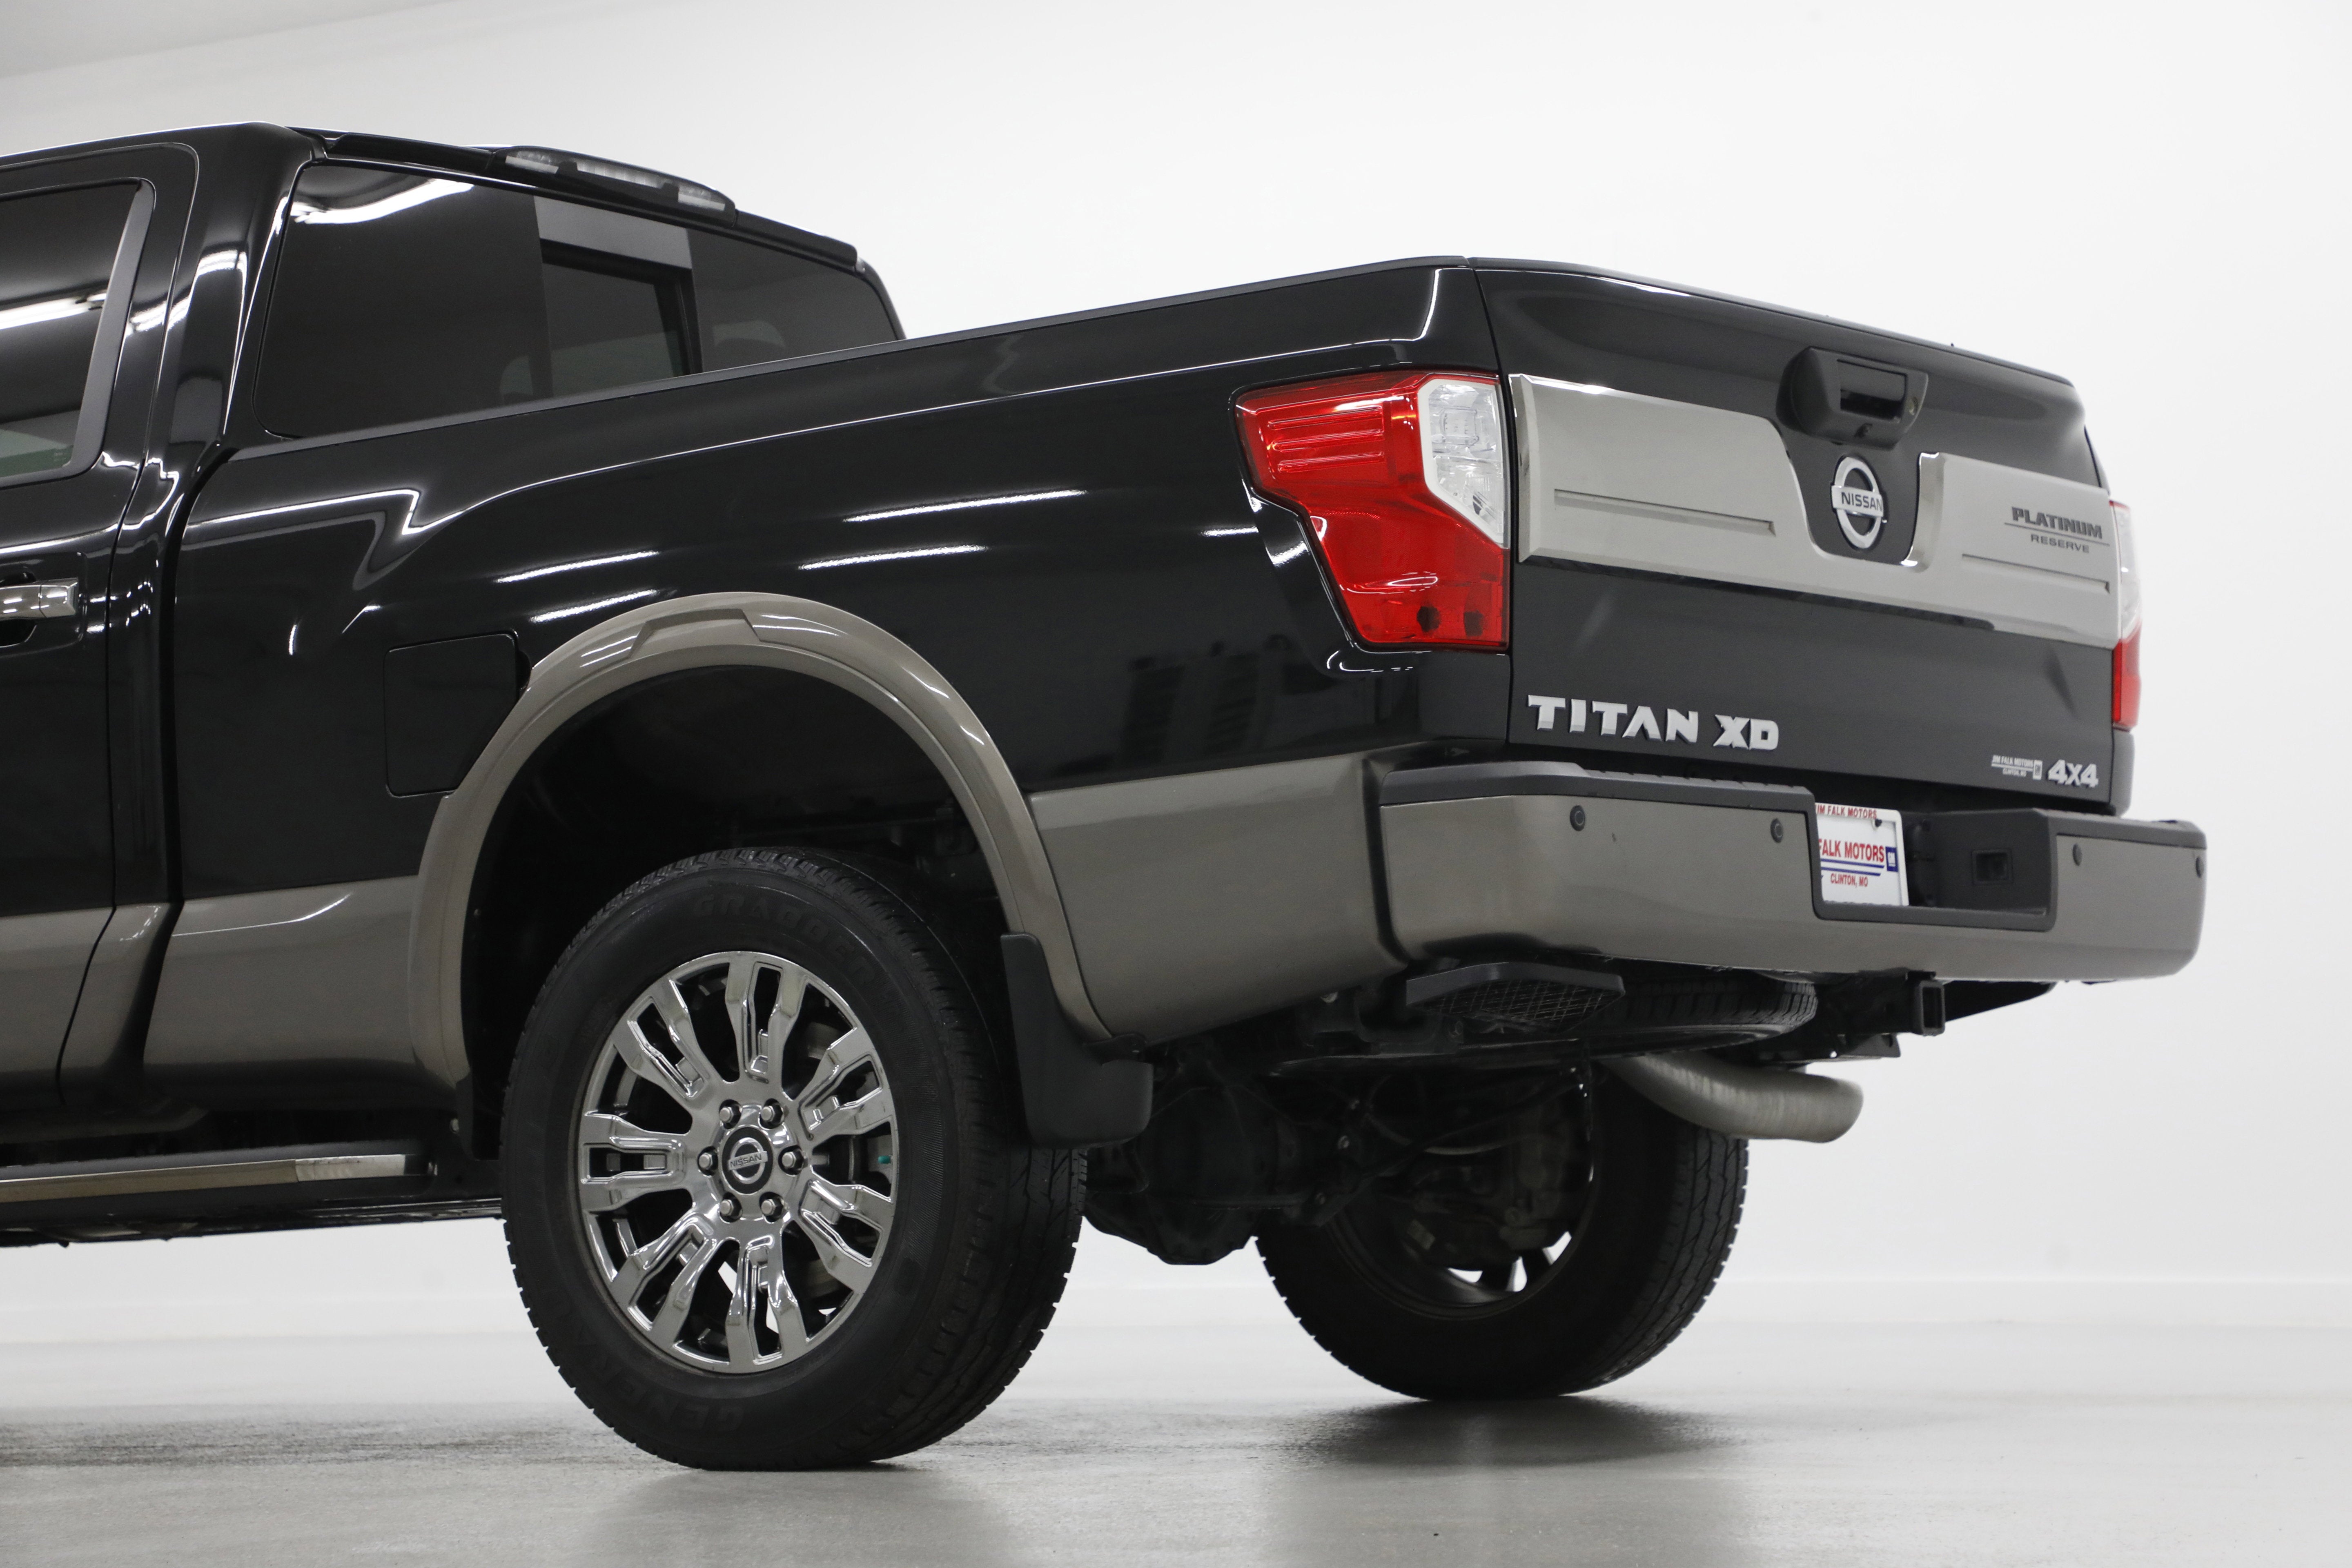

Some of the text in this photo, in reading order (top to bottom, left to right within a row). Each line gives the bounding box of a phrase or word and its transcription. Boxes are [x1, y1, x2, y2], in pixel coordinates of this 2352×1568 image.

[1841, 492, 1883, 511] NISSAN
[2011, 506, 2103, 539] PLATINUM
[2030, 533, 2089, 553] RESERVE
[1528, 695, 1779, 751] TITAN XD
[1827, 805, 1845, 816] FALK
[1847, 807, 1877, 819] MOTORS
[1844, 841, 1884, 862] MOTORS
[1830, 873, 1868, 887] CLINTON, MO
[730, 1153, 762, 1168] NISSAN
